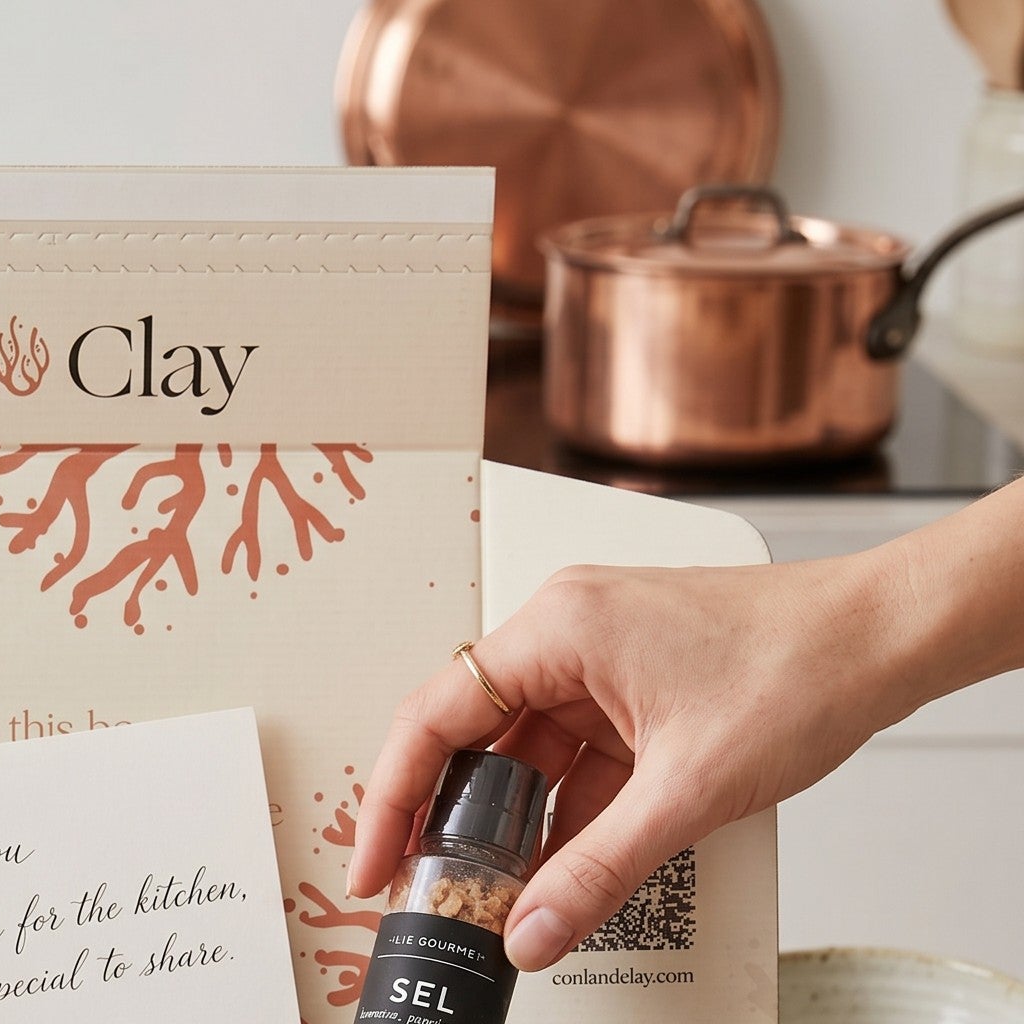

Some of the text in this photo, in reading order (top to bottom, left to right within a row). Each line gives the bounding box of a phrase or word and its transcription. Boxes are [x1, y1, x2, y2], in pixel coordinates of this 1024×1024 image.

[69, 315, 260, 417] Clay
[8, 709, 73, 743] this
[15, 894, 66, 954] for
[71, 882, 124, 927] the
[133, 866, 248, 916] kitchen,
[98, 949, 129, 984] to
[140, 932, 236, 978] share.
[552, 967, 694, 988] conlandelay.com
[389, 977, 454, 1015] SEL
